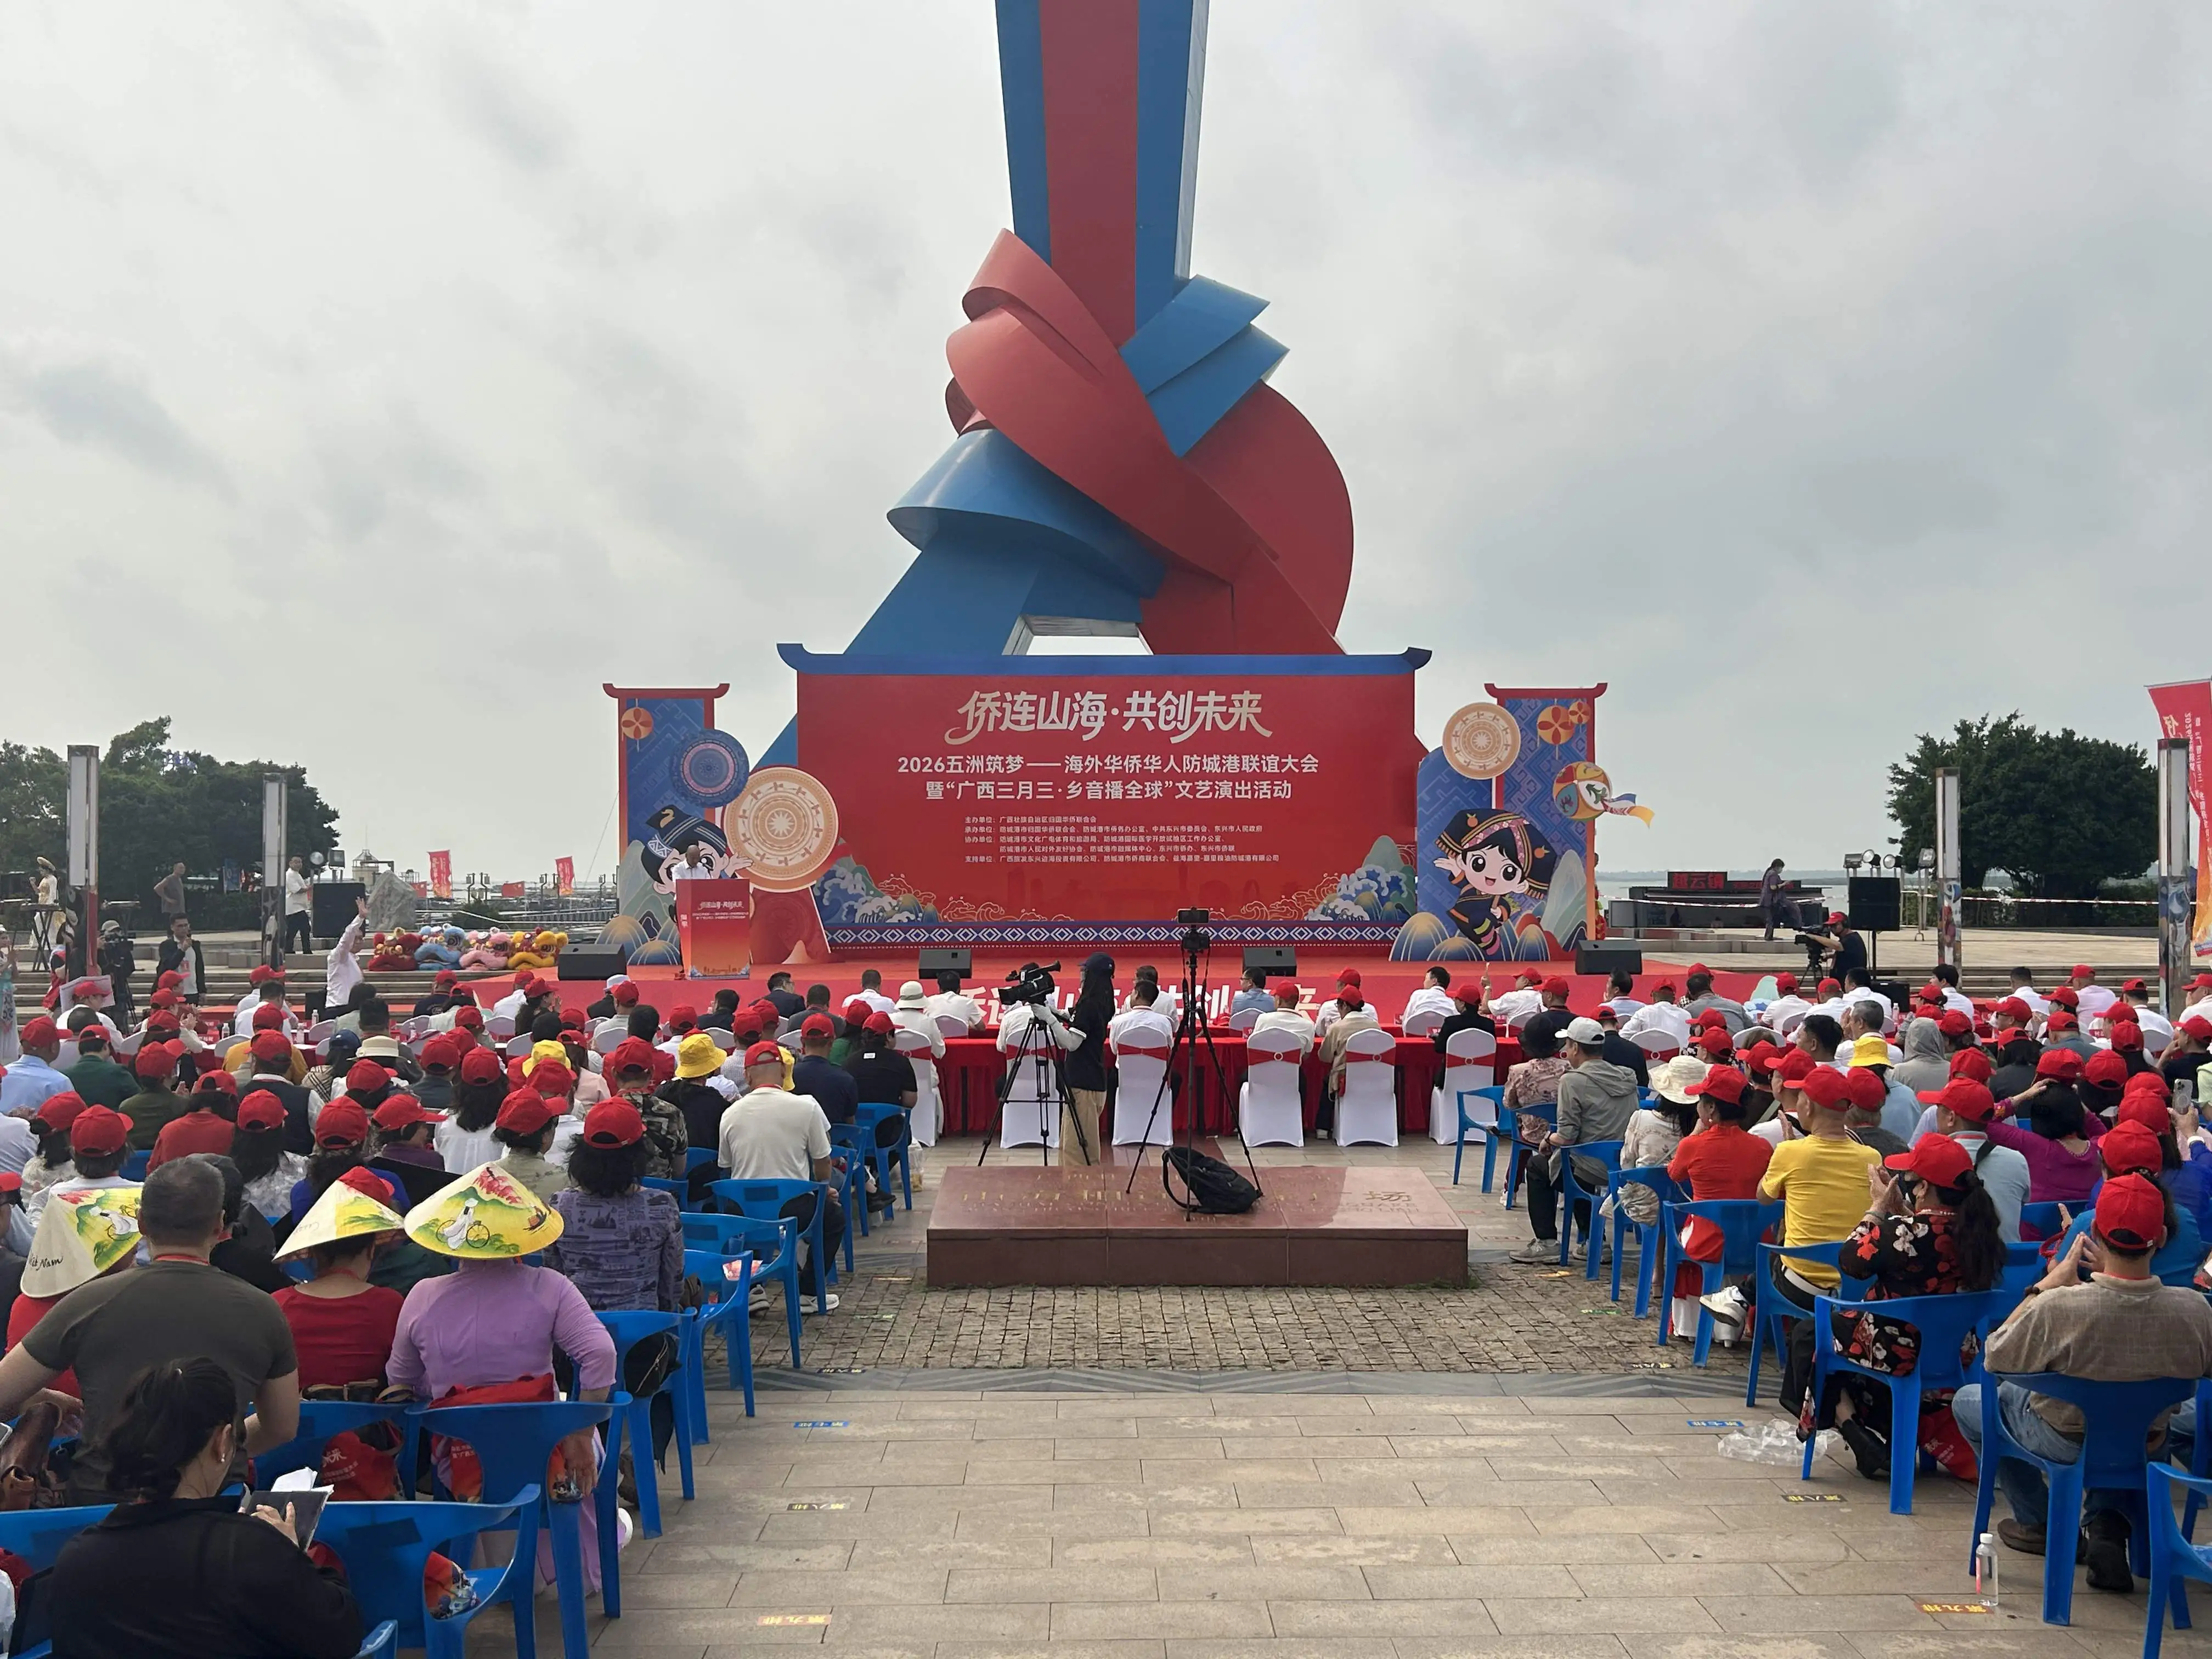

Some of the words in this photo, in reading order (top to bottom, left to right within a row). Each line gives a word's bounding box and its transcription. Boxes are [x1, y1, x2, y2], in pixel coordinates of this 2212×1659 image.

[944, 690, 1273, 745] 侨连山海·共创未来
